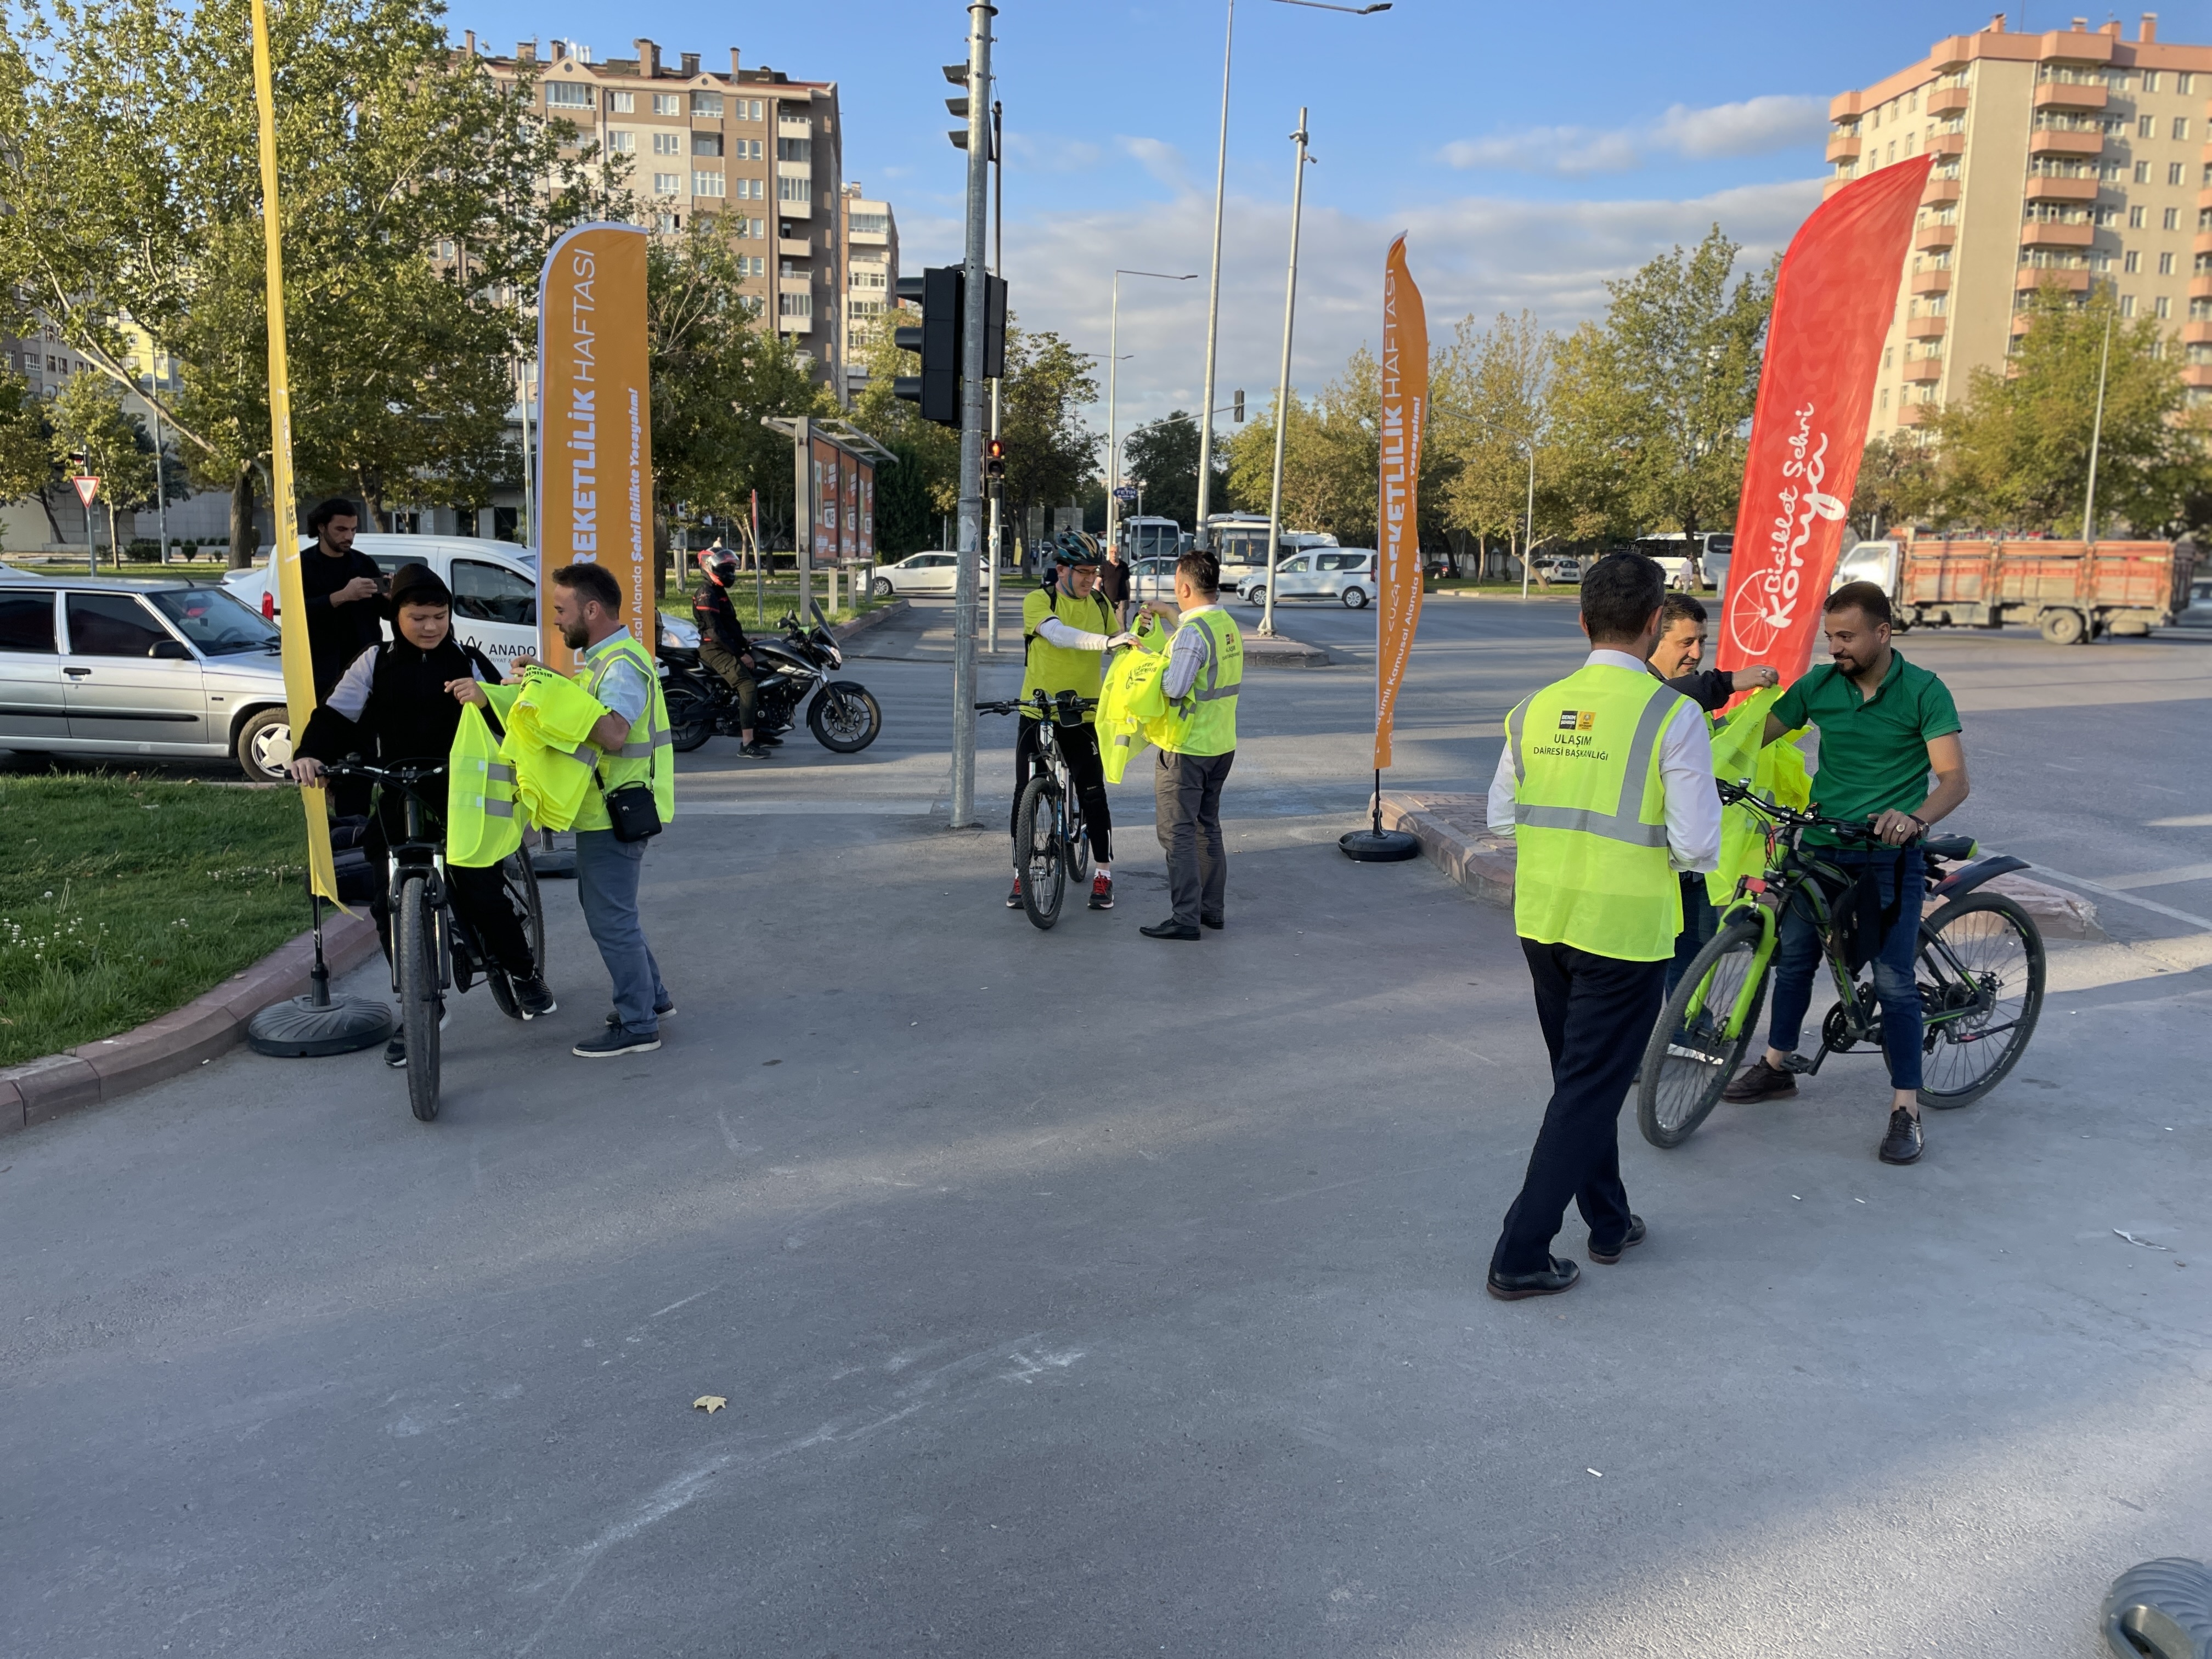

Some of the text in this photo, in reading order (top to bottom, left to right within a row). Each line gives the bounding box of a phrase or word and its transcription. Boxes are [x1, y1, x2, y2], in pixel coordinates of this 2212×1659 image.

[573, 249, 595, 382] HAFTASI
[1385, 269, 1401, 398] HAFTASI
[628, 387, 641, 466] Yaşayalım!
[629, 469, 641, 522] Birlikte
[1764, 402, 1814, 594] Bisiklet Şehri
[630, 523, 644, 562] Şehri
[1765, 432, 1846, 629] Konya
[632, 566, 642, 614] Alanda
[489, 644, 536, 657] ANADO
[1387, 628, 1409, 685] Kamusal
[1405, 577, 1419, 625] Alanda
[1533, 746, 1609, 761] DAİRESİ BAŞKANLIĞI
[1554, 733, 1592, 747] ULAŞIM
